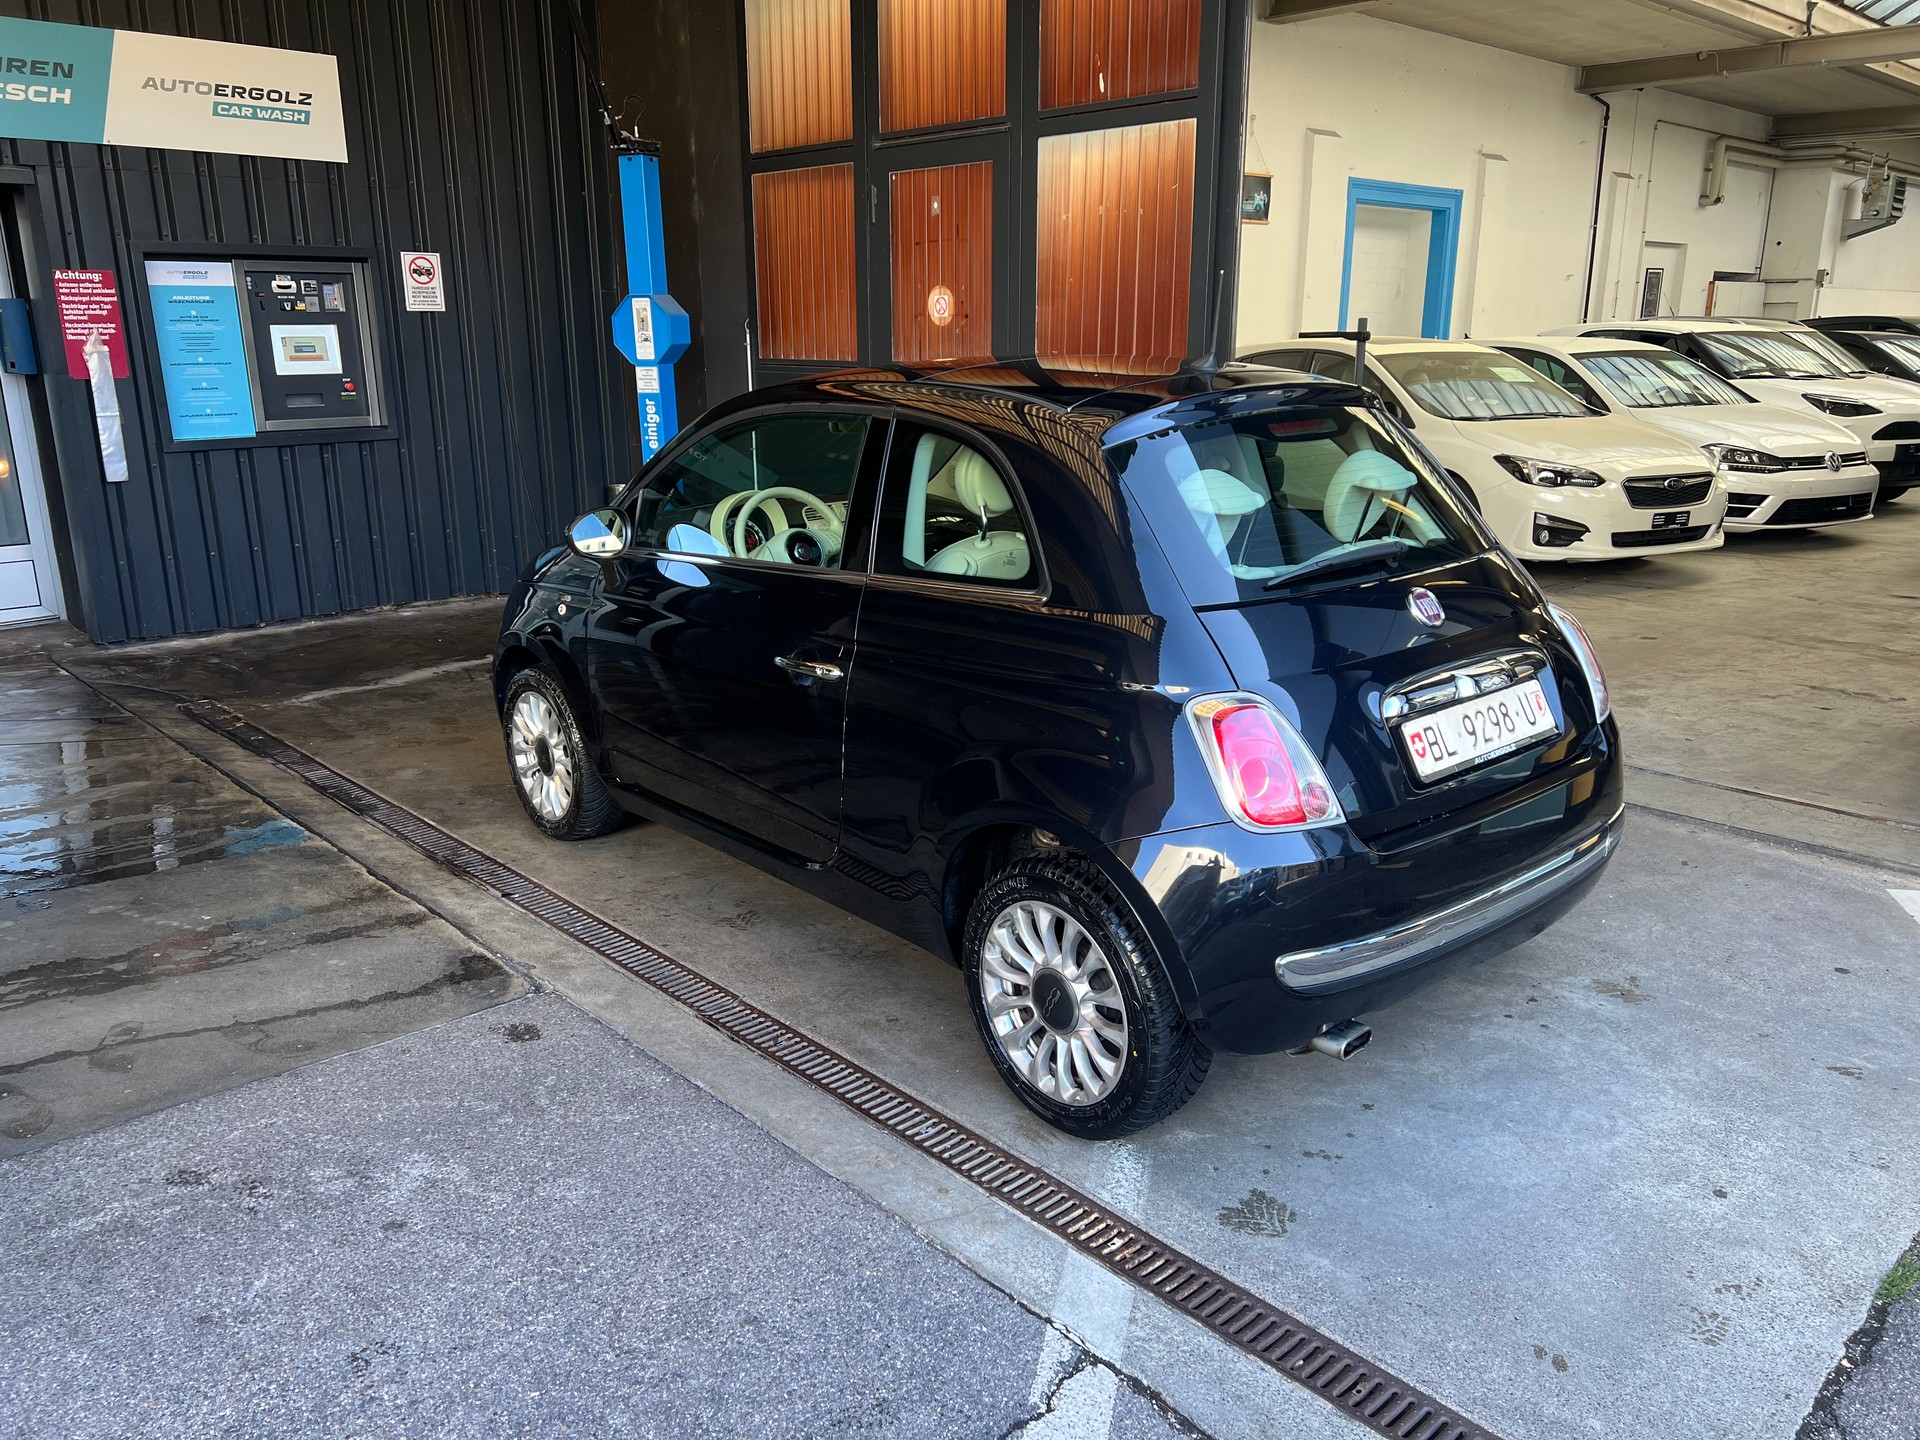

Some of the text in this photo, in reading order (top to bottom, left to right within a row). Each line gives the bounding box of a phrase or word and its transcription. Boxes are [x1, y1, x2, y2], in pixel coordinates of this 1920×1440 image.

[0, 57, 74, 79] REN
[0, 83, 72, 105] SCH
[141, 76, 313, 106] AUTOERGOLZ
[216, 104, 306, 123] CAR WASH
[55, 271, 102, 282] Achtung:
[644, 398, 660, 449] einiger
[1423, 693, 1537, 762] BL 9298 U
